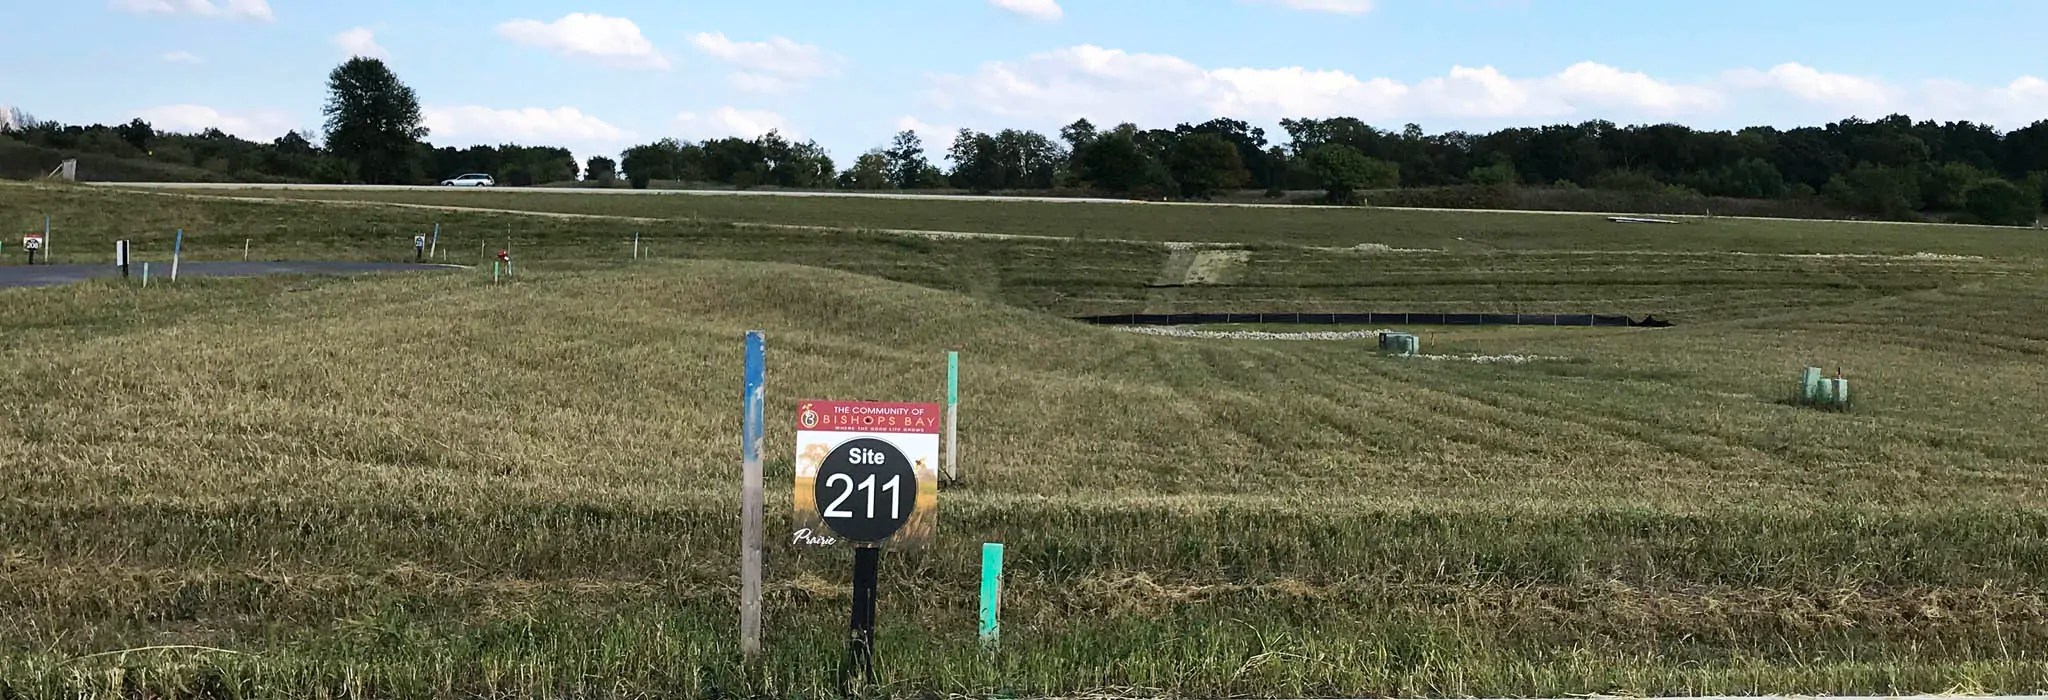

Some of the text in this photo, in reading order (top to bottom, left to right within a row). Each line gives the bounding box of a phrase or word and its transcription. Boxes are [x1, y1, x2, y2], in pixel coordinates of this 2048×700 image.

[834, 406, 924, 416] THE COMMUNITY OF
[823, 415, 935, 427] BISHOPS BAY
[849, 447, 885, 464] Site
[823, 473, 900, 519] 211
[793, 528, 837, 545] Prairie
